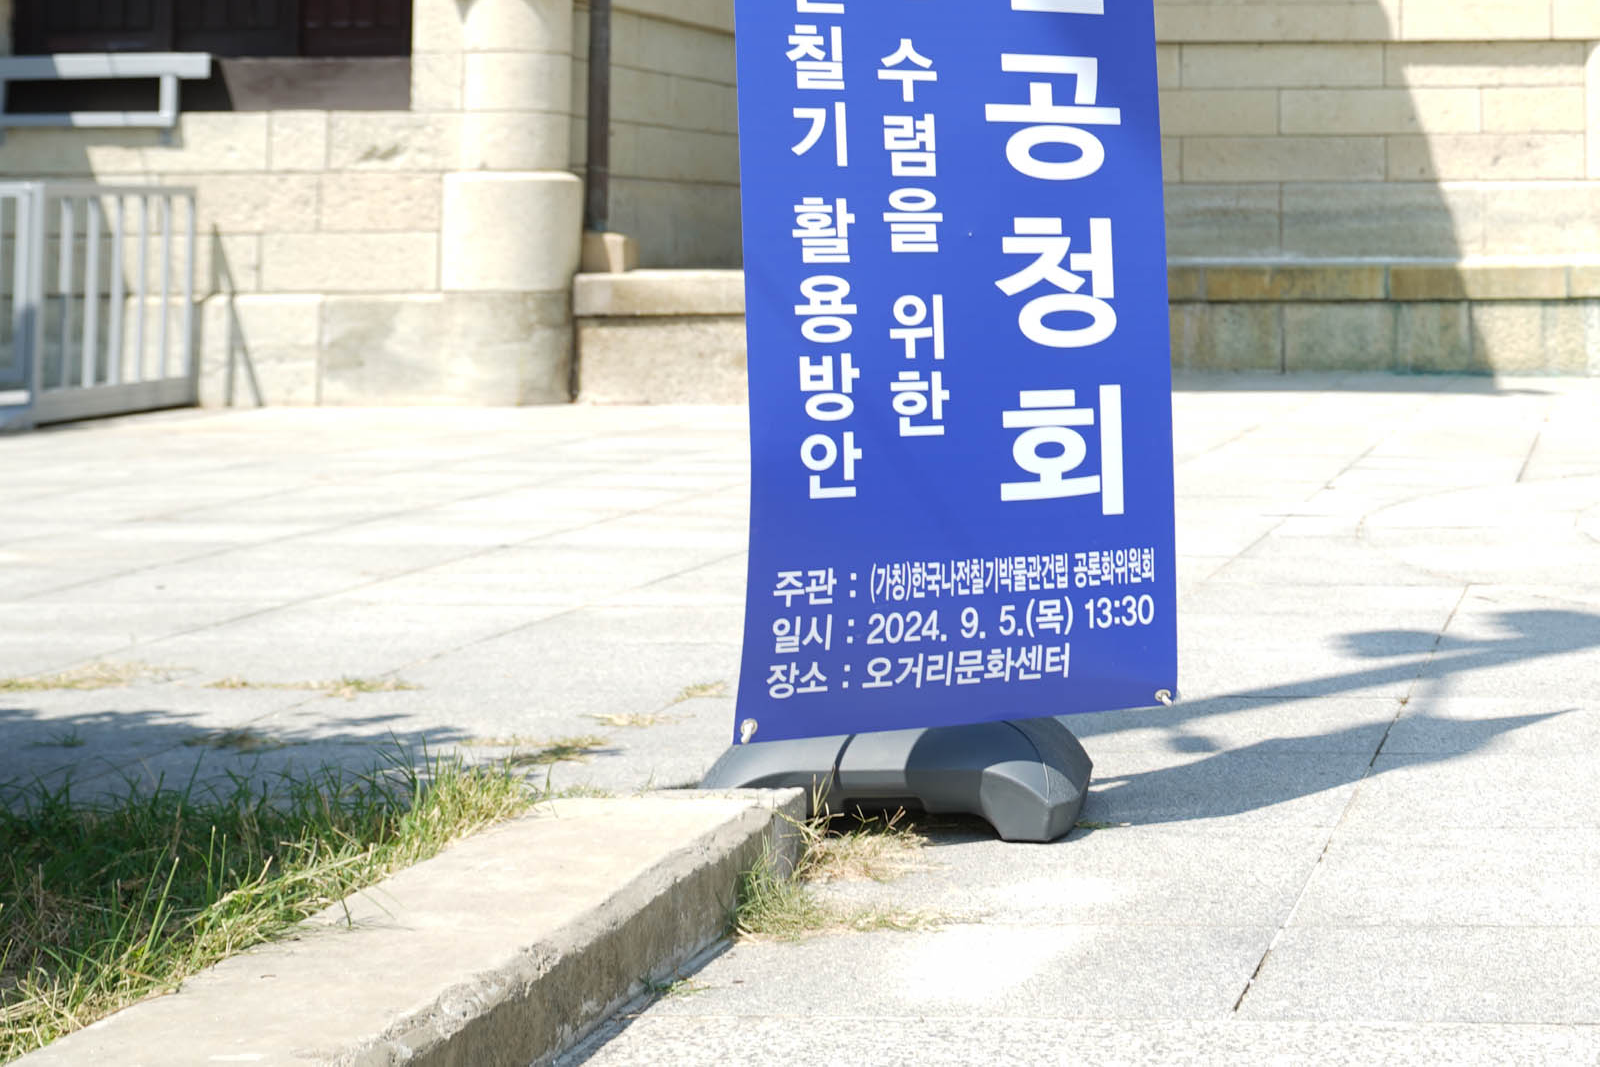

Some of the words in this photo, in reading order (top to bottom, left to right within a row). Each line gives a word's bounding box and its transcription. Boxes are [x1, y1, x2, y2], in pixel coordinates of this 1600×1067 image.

[877, 37, 944, 253] 수렴을
[792, 197, 863, 500] 활용방안
[889, 293, 950, 437] 위한
[772, 613, 833, 654] 일시
[866, 609, 948, 645] 2024.
[960, 606, 987, 640] 9.
[1084, 593, 1155, 629] 13:30
[773, 567, 838, 608] 주관
[870, 552, 1069, 604] (가칭)한국나전칠기박물관건립
[1073, 546, 1155, 589] 공론화위원회
[766, 661, 828, 699] 장소
[862, 642, 1070, 689] 오거리문화센터
